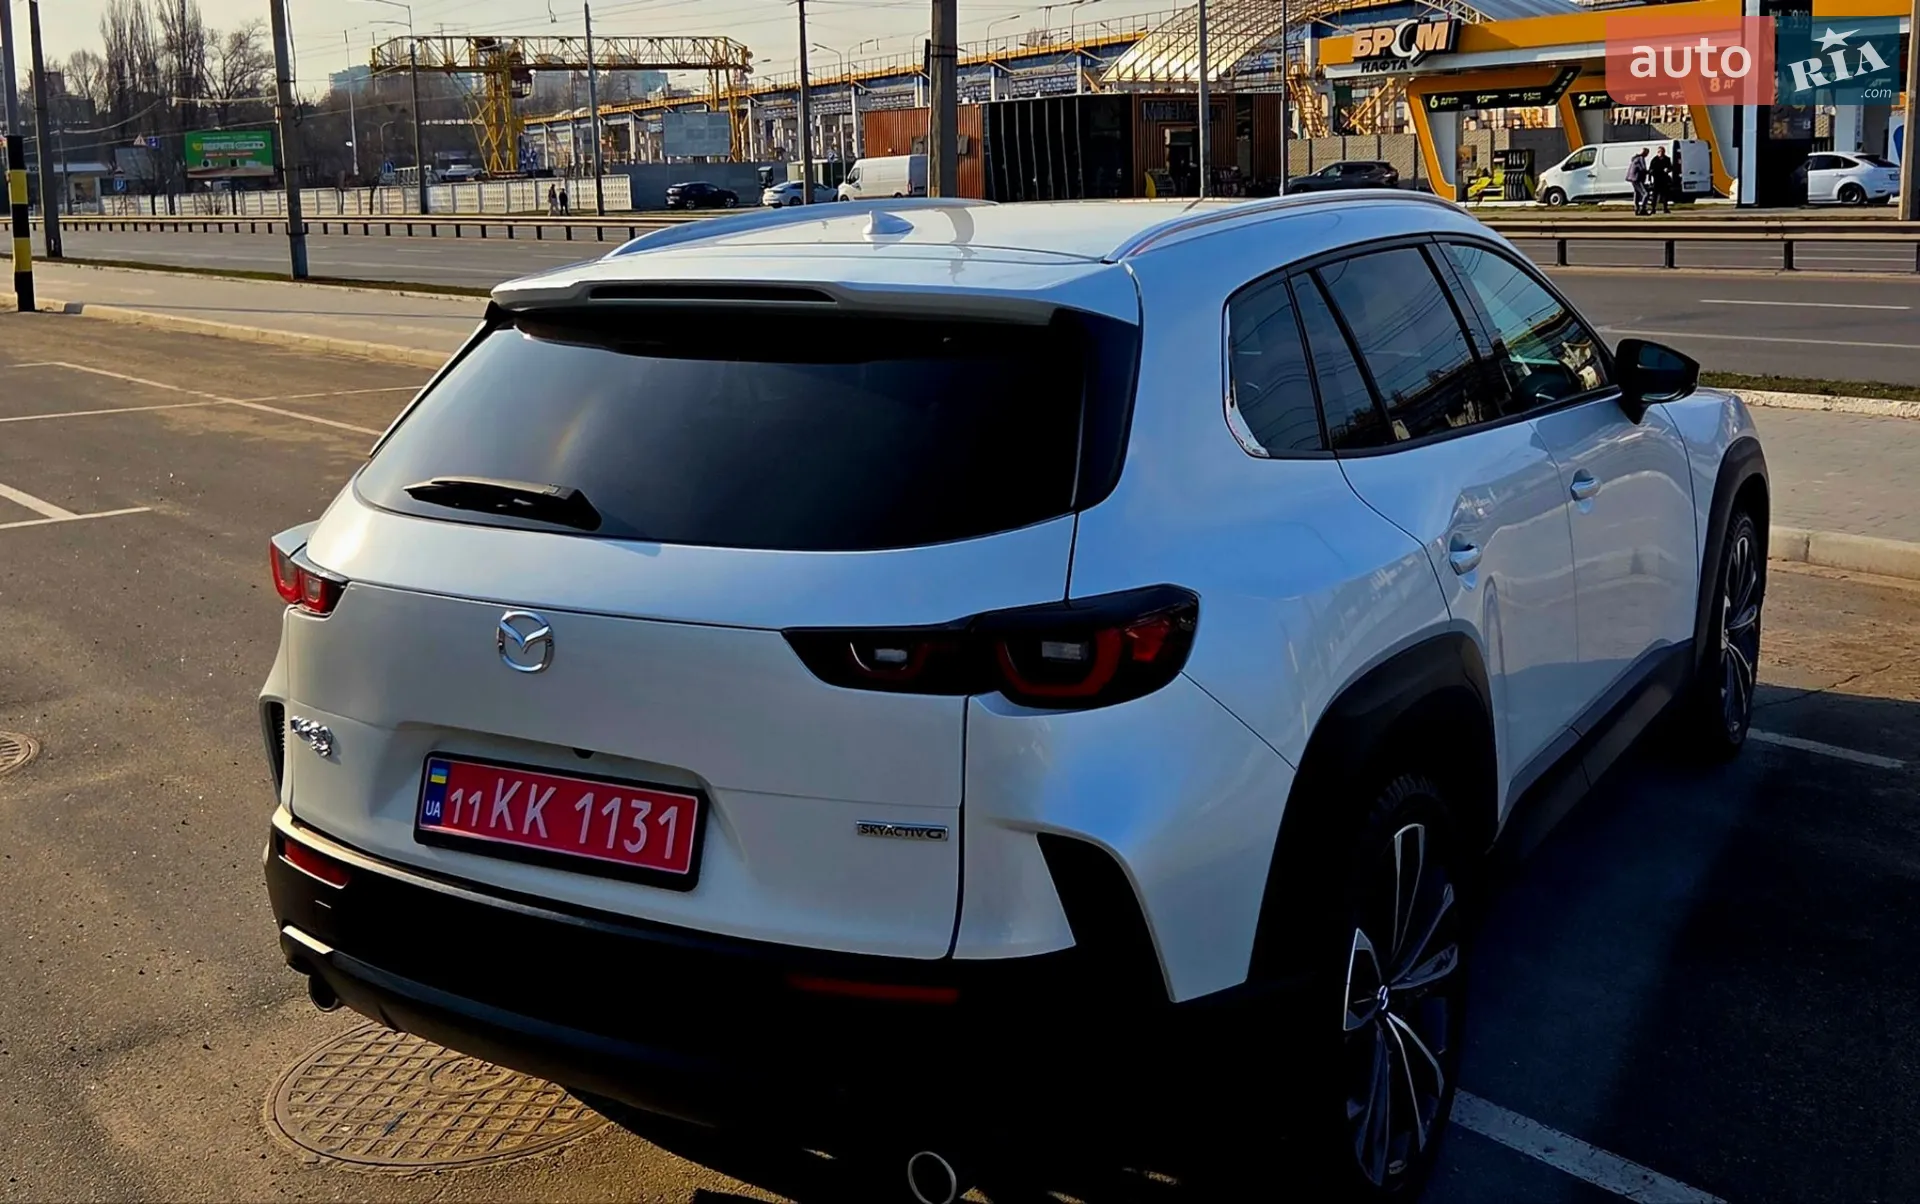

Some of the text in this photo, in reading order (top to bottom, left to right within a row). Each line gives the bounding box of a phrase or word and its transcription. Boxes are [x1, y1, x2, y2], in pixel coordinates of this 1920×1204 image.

[1360, 59, 1408, 73] НАФТА
[1429, 95, 1439, 109] 6
[1578, 94, 1588, 107] 2
[425, 800, 441, 818] UA
[574, 792, 678, 860] 1131
